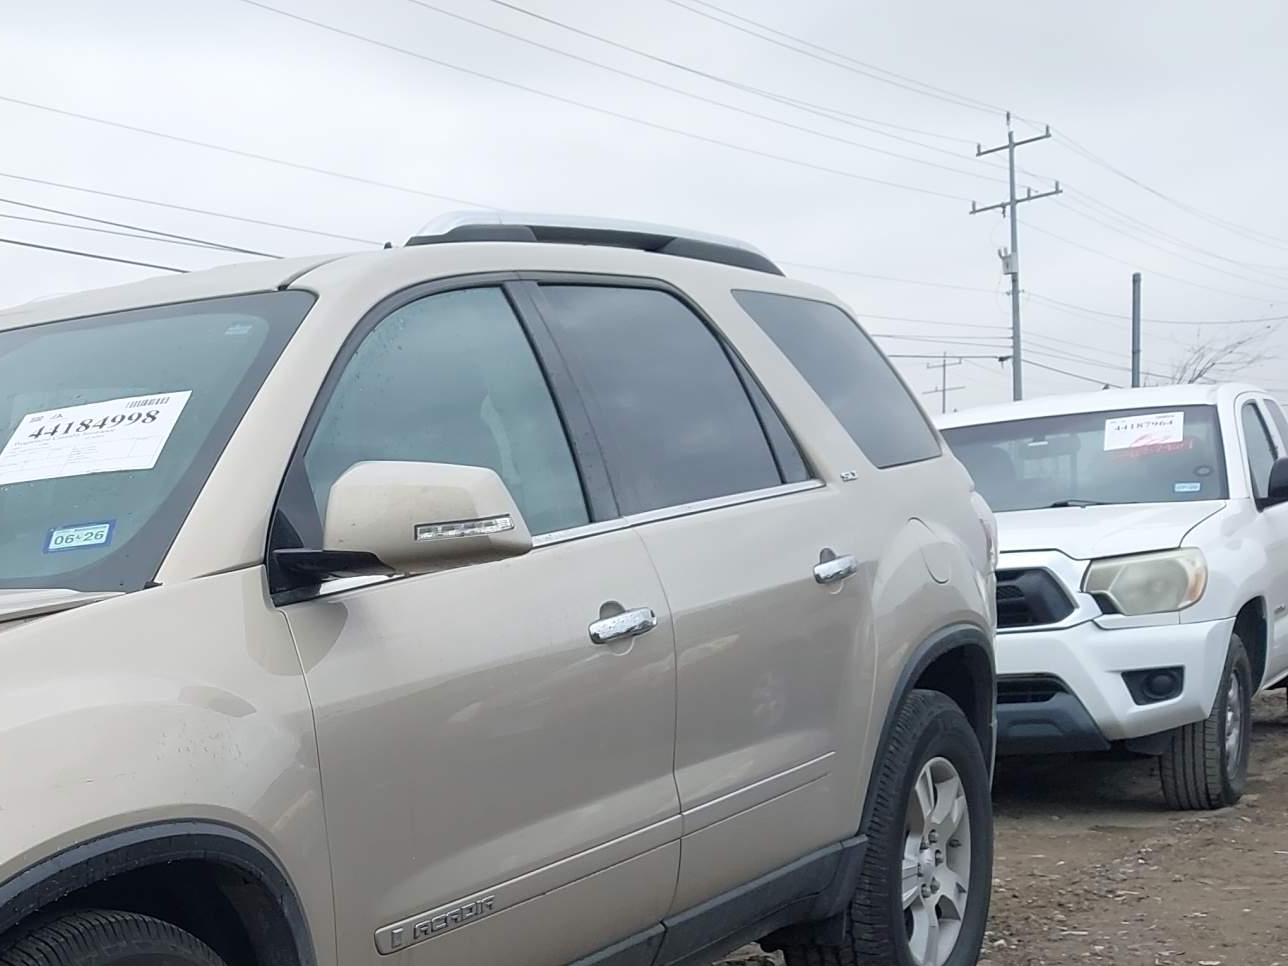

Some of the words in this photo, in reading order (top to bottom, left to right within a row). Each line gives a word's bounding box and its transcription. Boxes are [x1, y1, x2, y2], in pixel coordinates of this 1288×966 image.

[28, 409, 160, 440] 44184998
[54, 534, 76, 546] 06
[83, 530, 105, 542] 26
